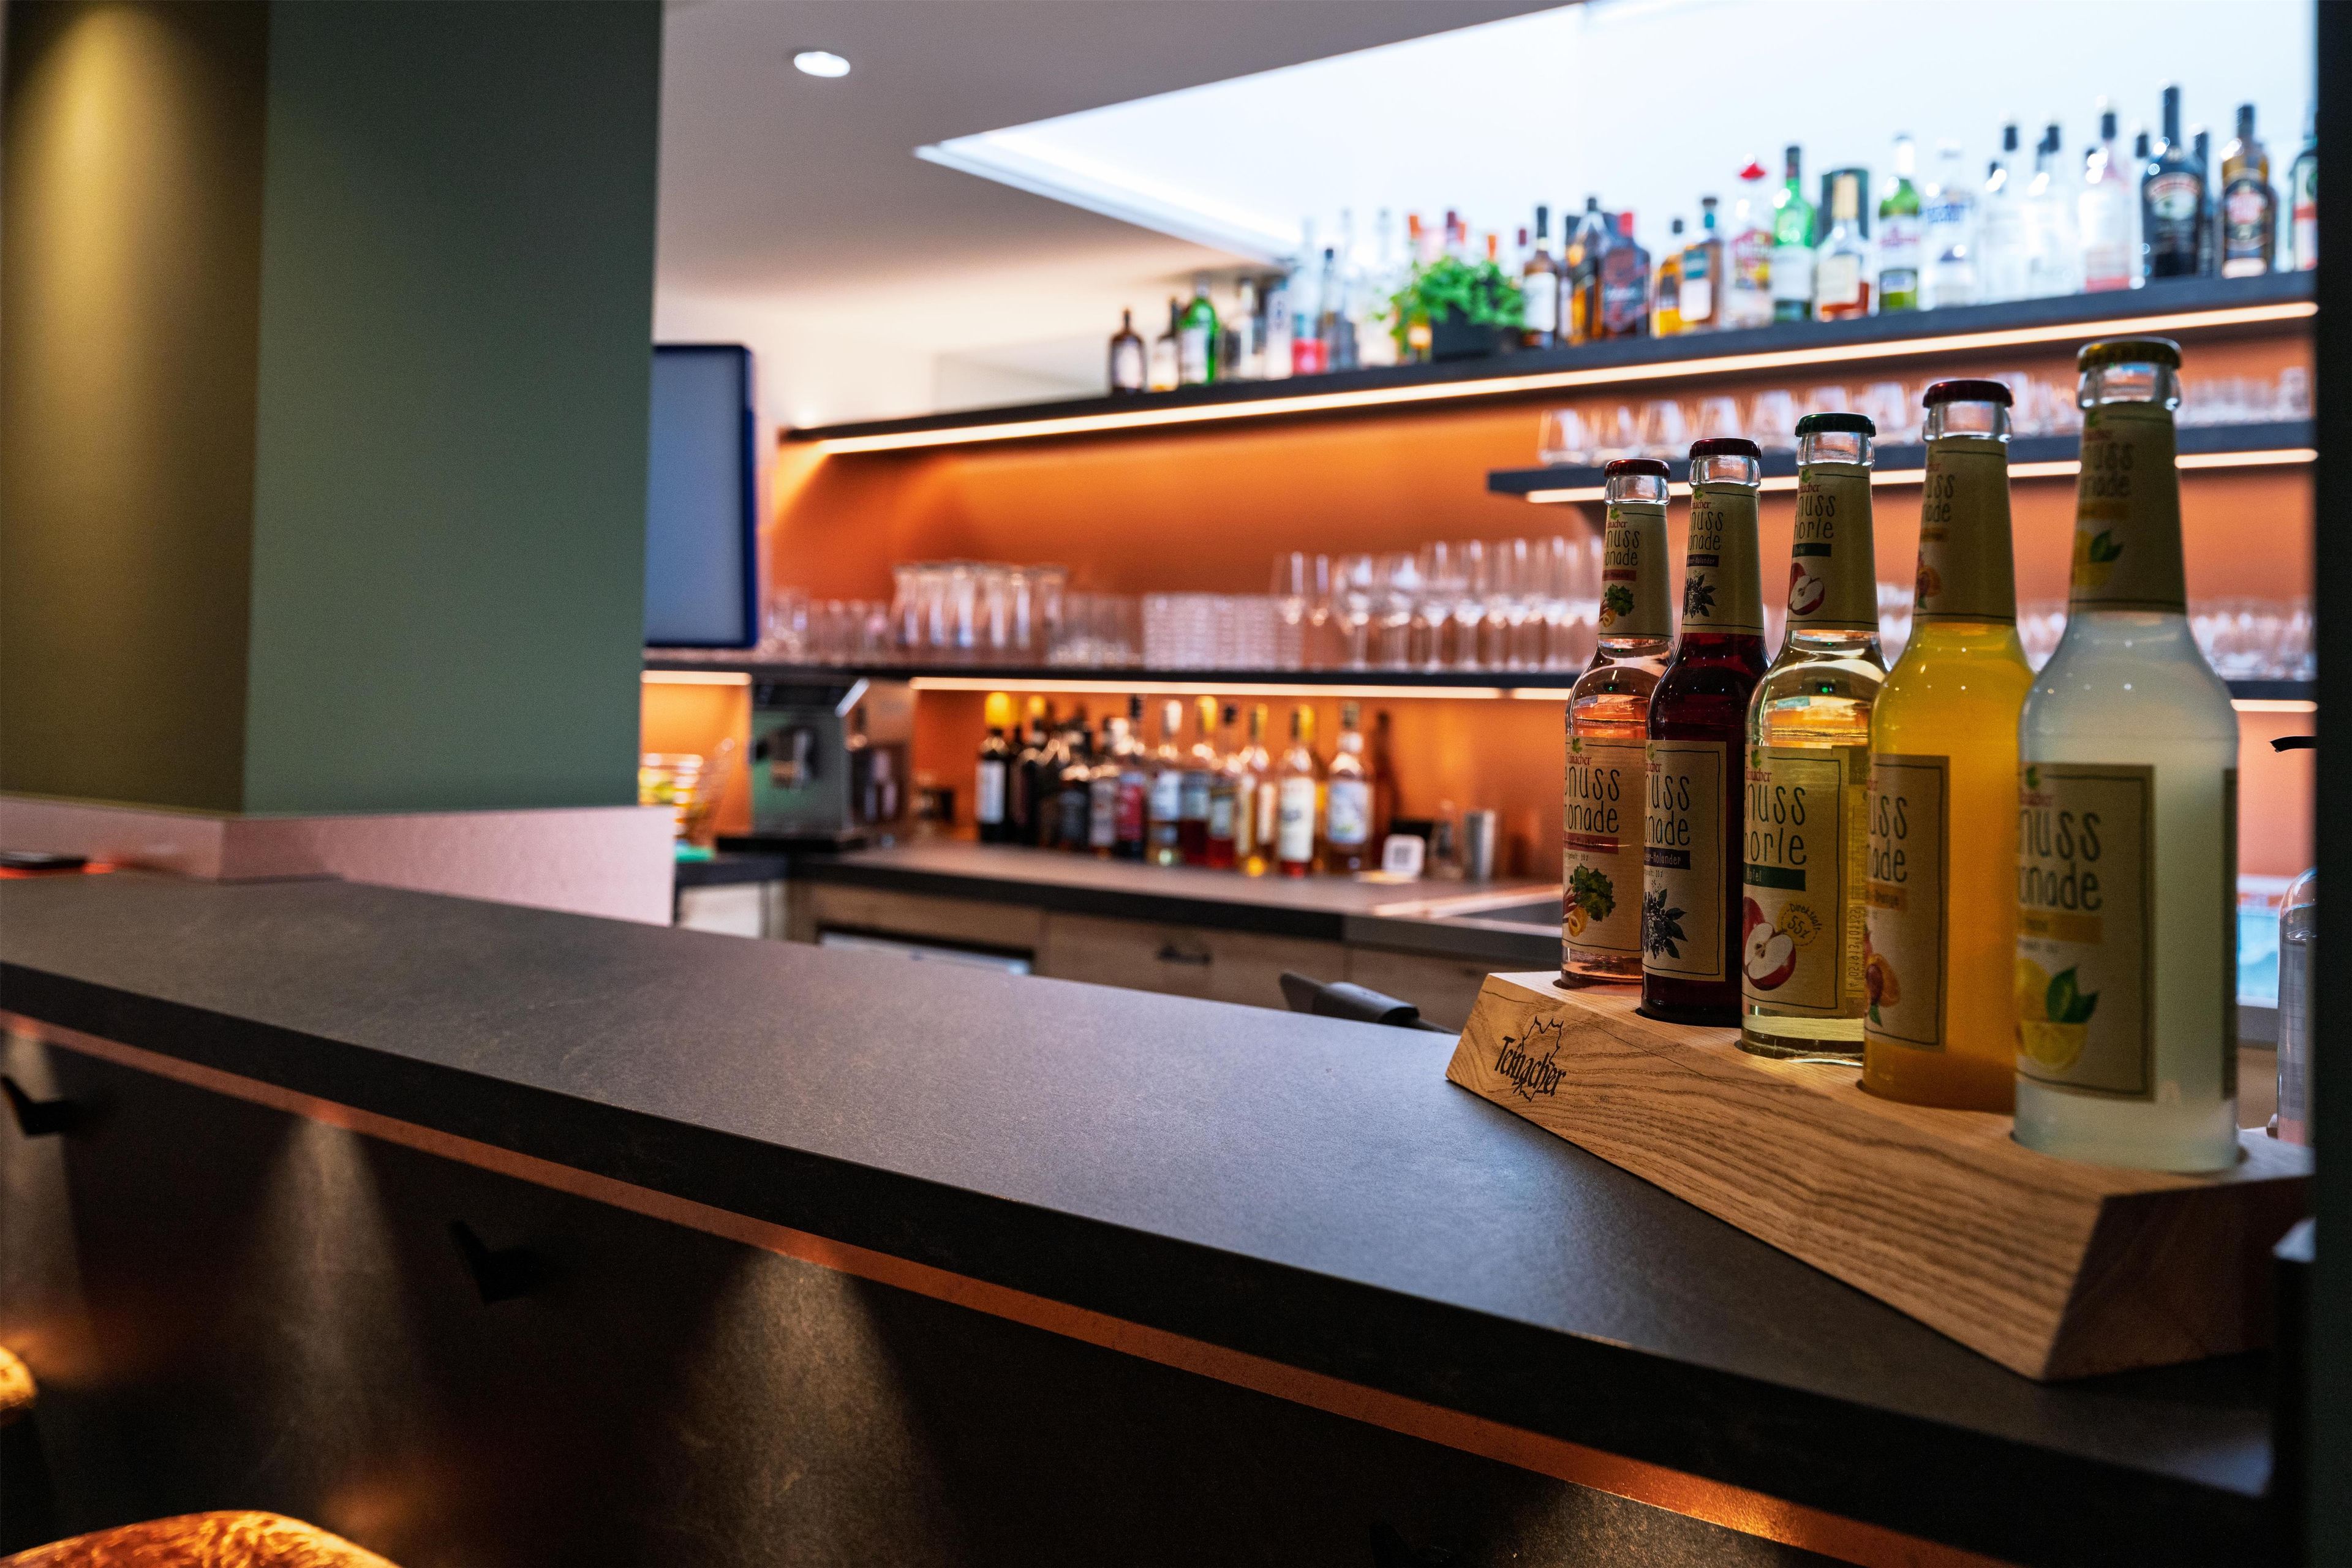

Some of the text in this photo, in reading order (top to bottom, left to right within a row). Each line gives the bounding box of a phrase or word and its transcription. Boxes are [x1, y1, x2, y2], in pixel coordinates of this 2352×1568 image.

[1607, 530, 1640, 549] nuss
[1605, 548, 1638, 566] onade
[1645, 774, 1691, 812] nuss
